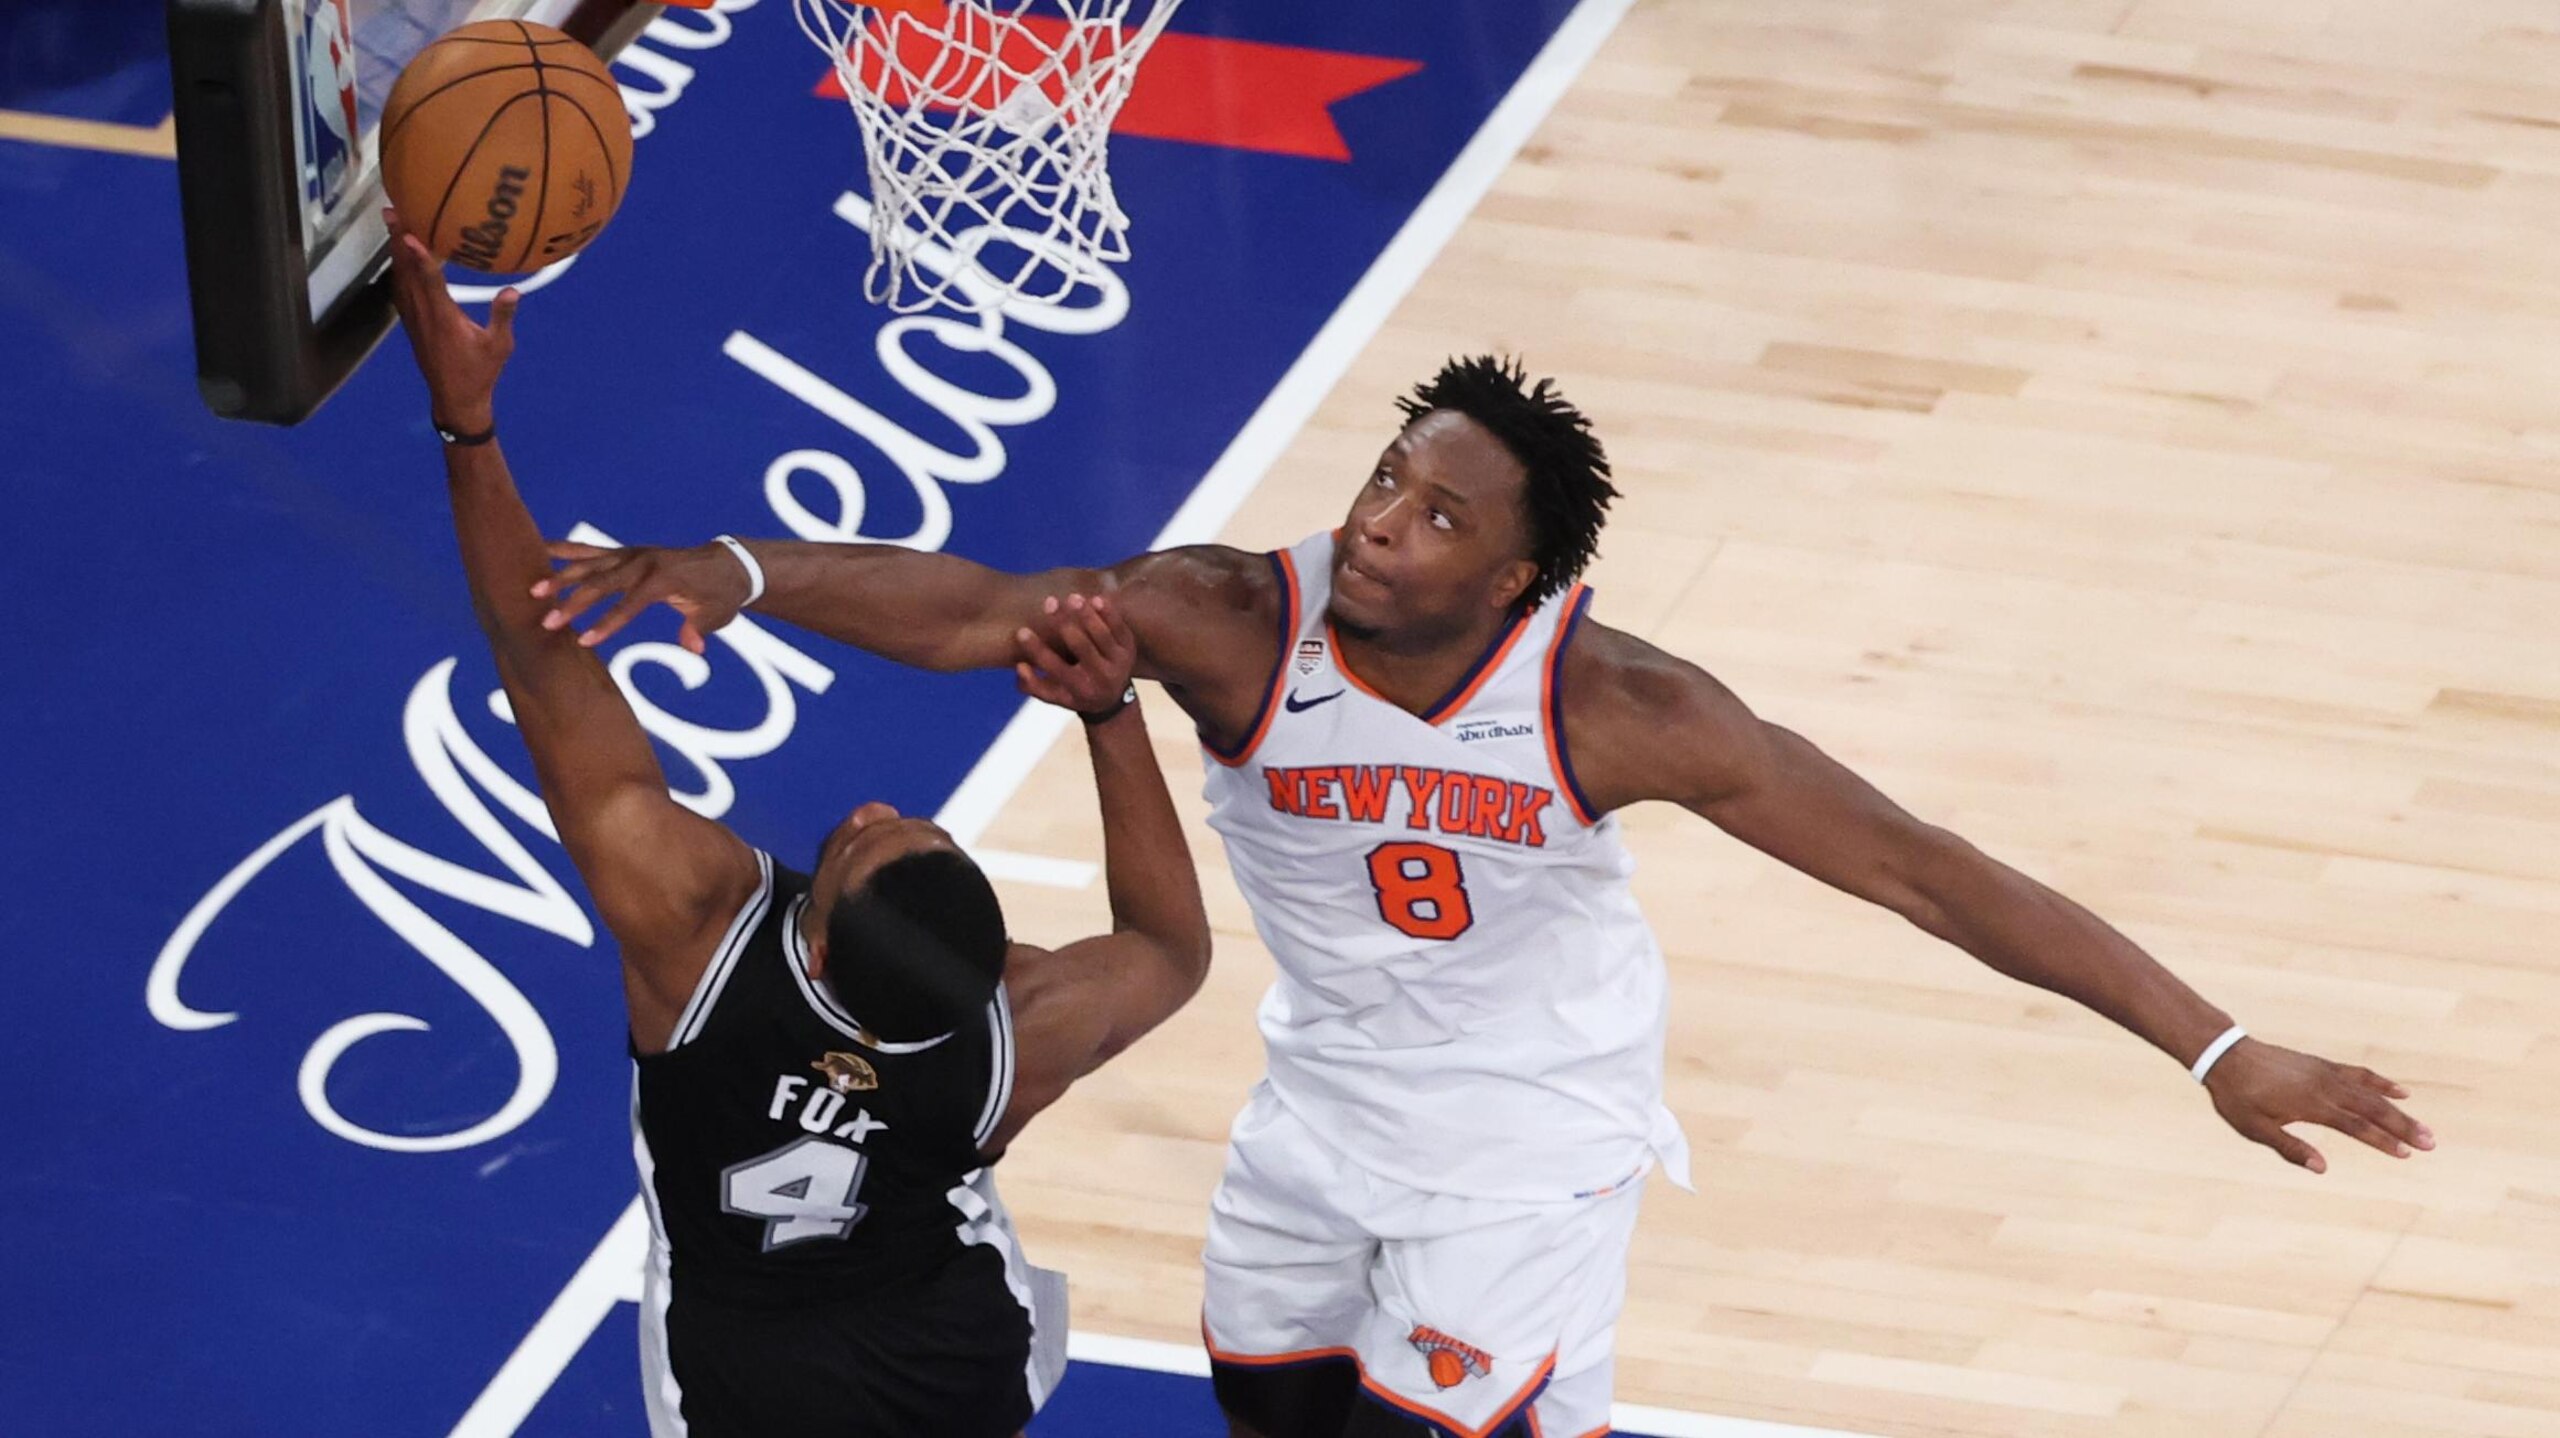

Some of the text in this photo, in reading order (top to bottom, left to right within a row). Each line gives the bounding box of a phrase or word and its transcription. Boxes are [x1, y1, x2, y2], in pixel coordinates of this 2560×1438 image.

[1262, 765, 1553, 848] NEW YORK
[1364, 840, 1475, 941] 8
[768, 1073, 890, 1145] FOX
[720, 1134, 869, 1254] 4
